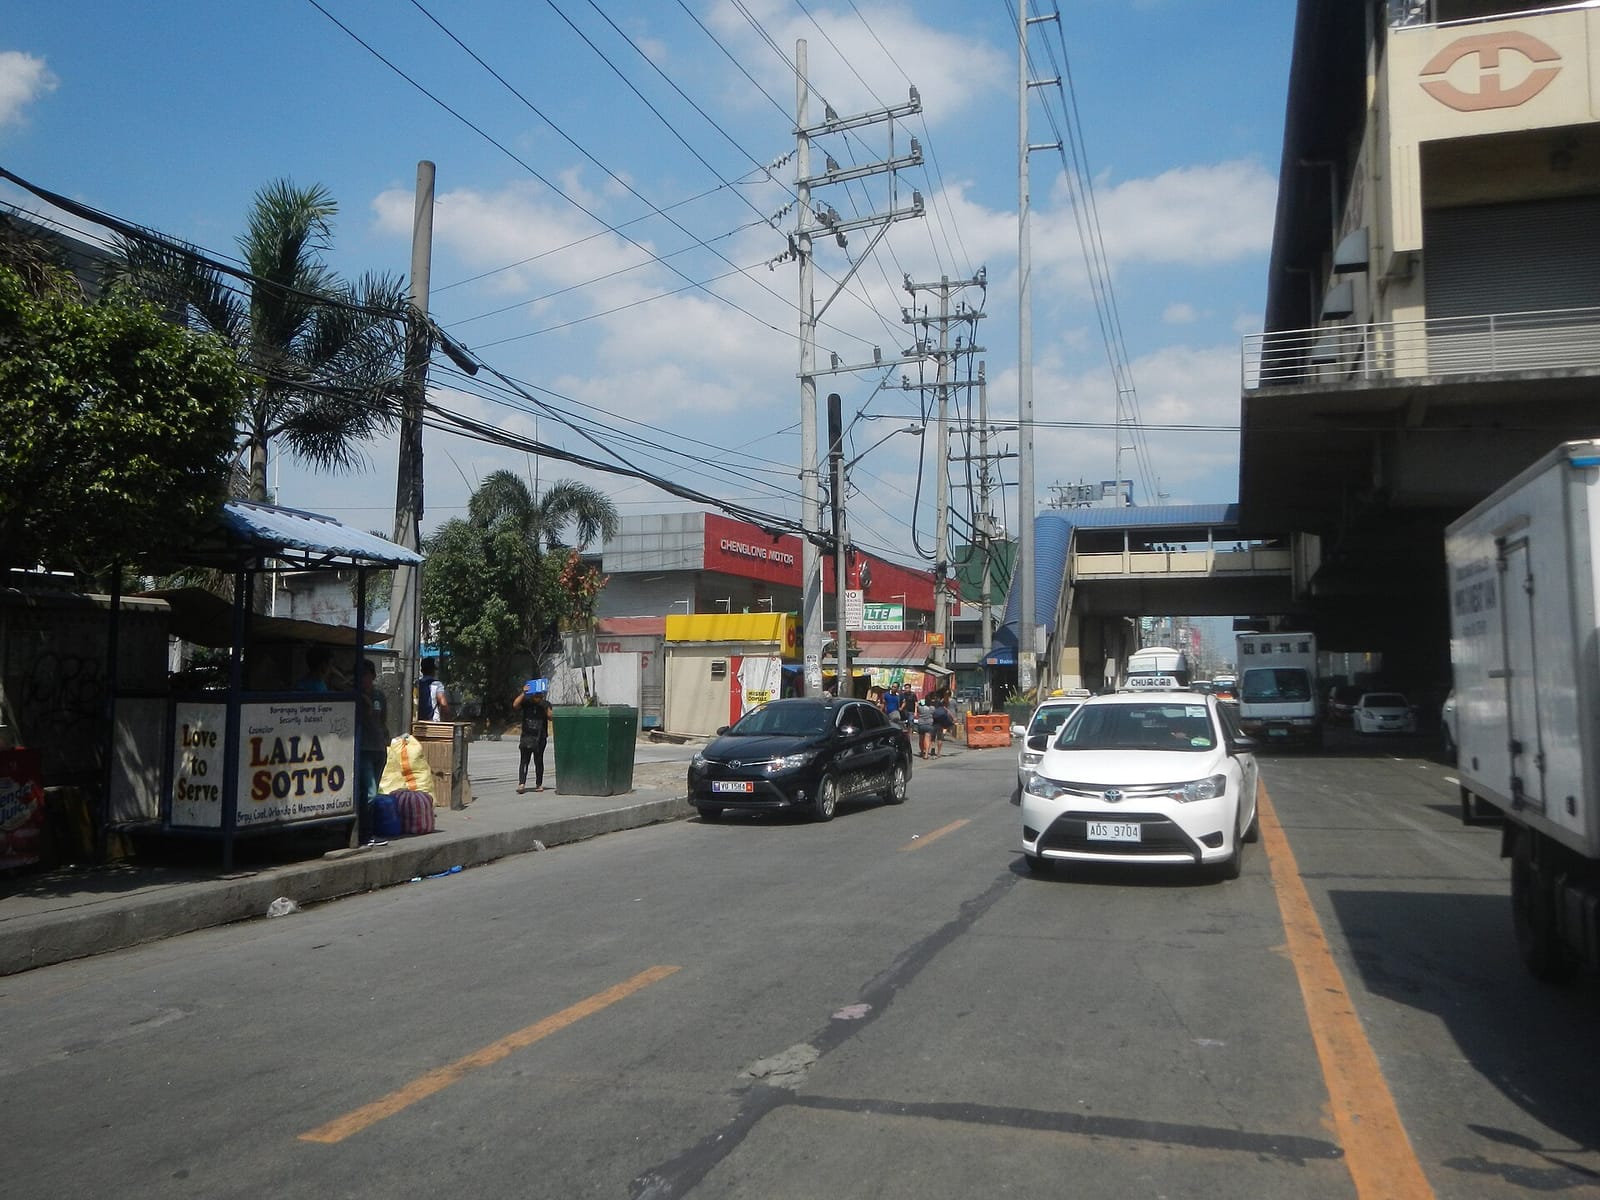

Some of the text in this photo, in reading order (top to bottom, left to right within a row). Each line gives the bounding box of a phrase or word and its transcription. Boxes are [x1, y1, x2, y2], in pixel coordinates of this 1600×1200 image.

[720, 539, 794, 565] CHENGLONG MOTOR
[270, 705, 298, 716] Barangay
[280, 716, 301, 725] Security
[182, 723, 218, 748] Love
[250, 735, 325, 767] LALA
[190, 755, 208, 777] to
[177, 777, 219, 802] Serve
[251, 765, 346, 801] SOTTO
[1113, 825, 1138, 837] 9704
